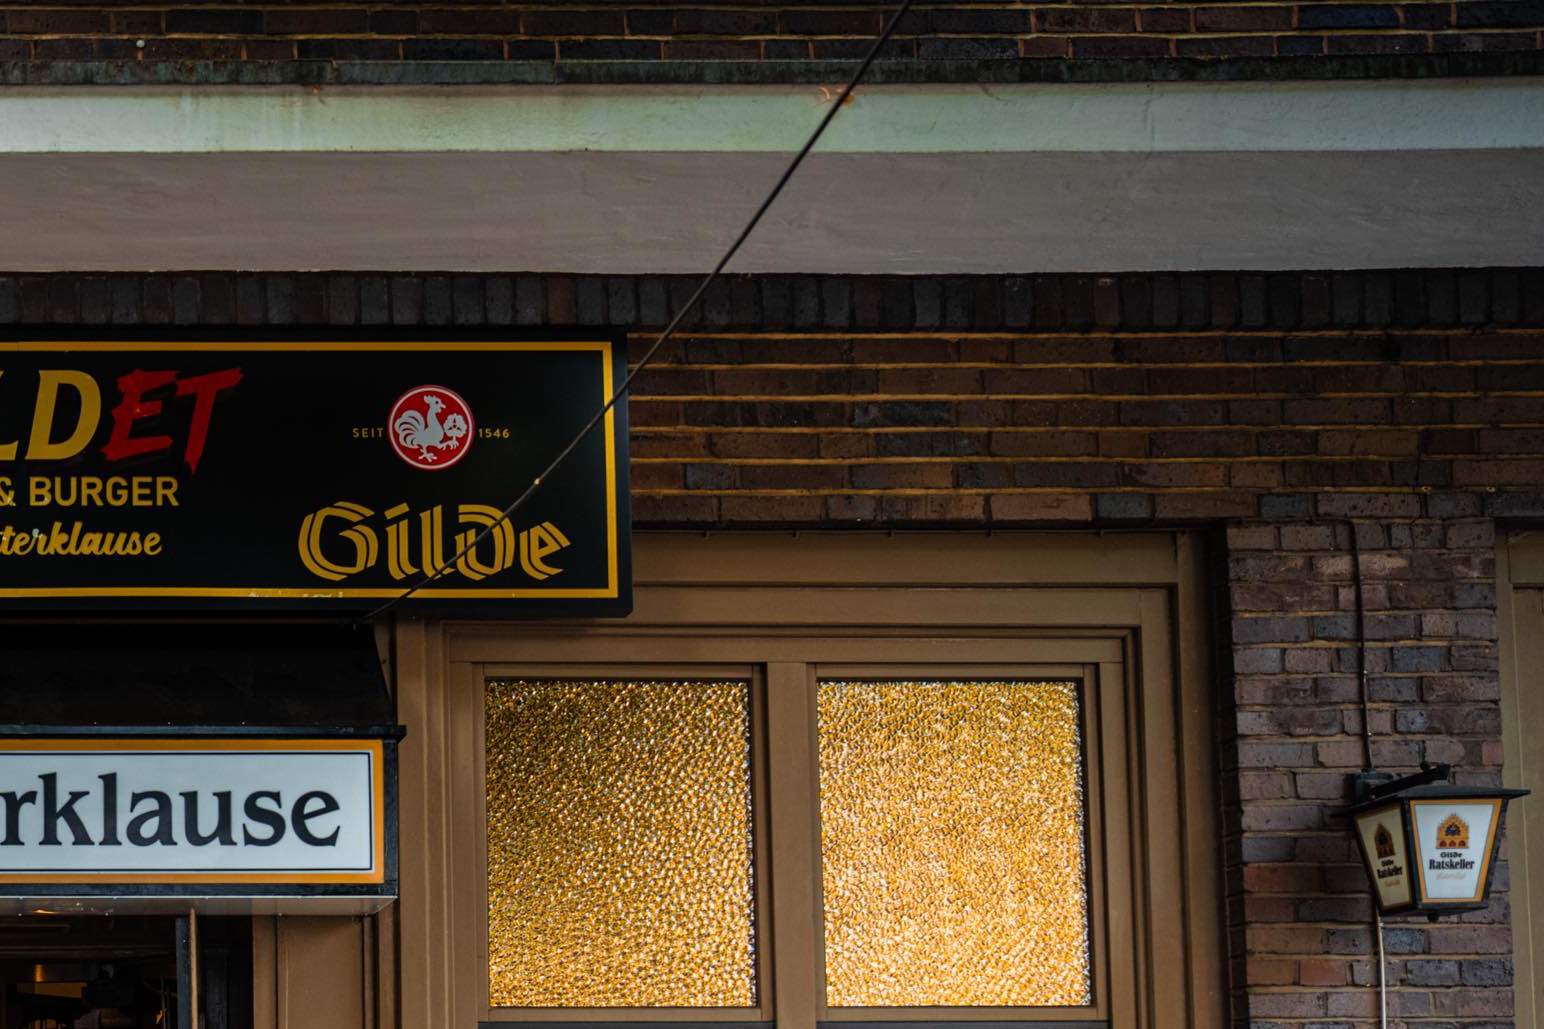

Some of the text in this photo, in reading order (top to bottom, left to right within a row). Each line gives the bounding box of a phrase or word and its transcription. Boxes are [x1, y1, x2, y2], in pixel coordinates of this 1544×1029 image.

[352, 427, 510, 439] SEIT 1546
[29, 476, 180, 507] BURGER
[297, 501, 572, 582] Gilde
[1428, 858, 1475, 870] Ratskeller
